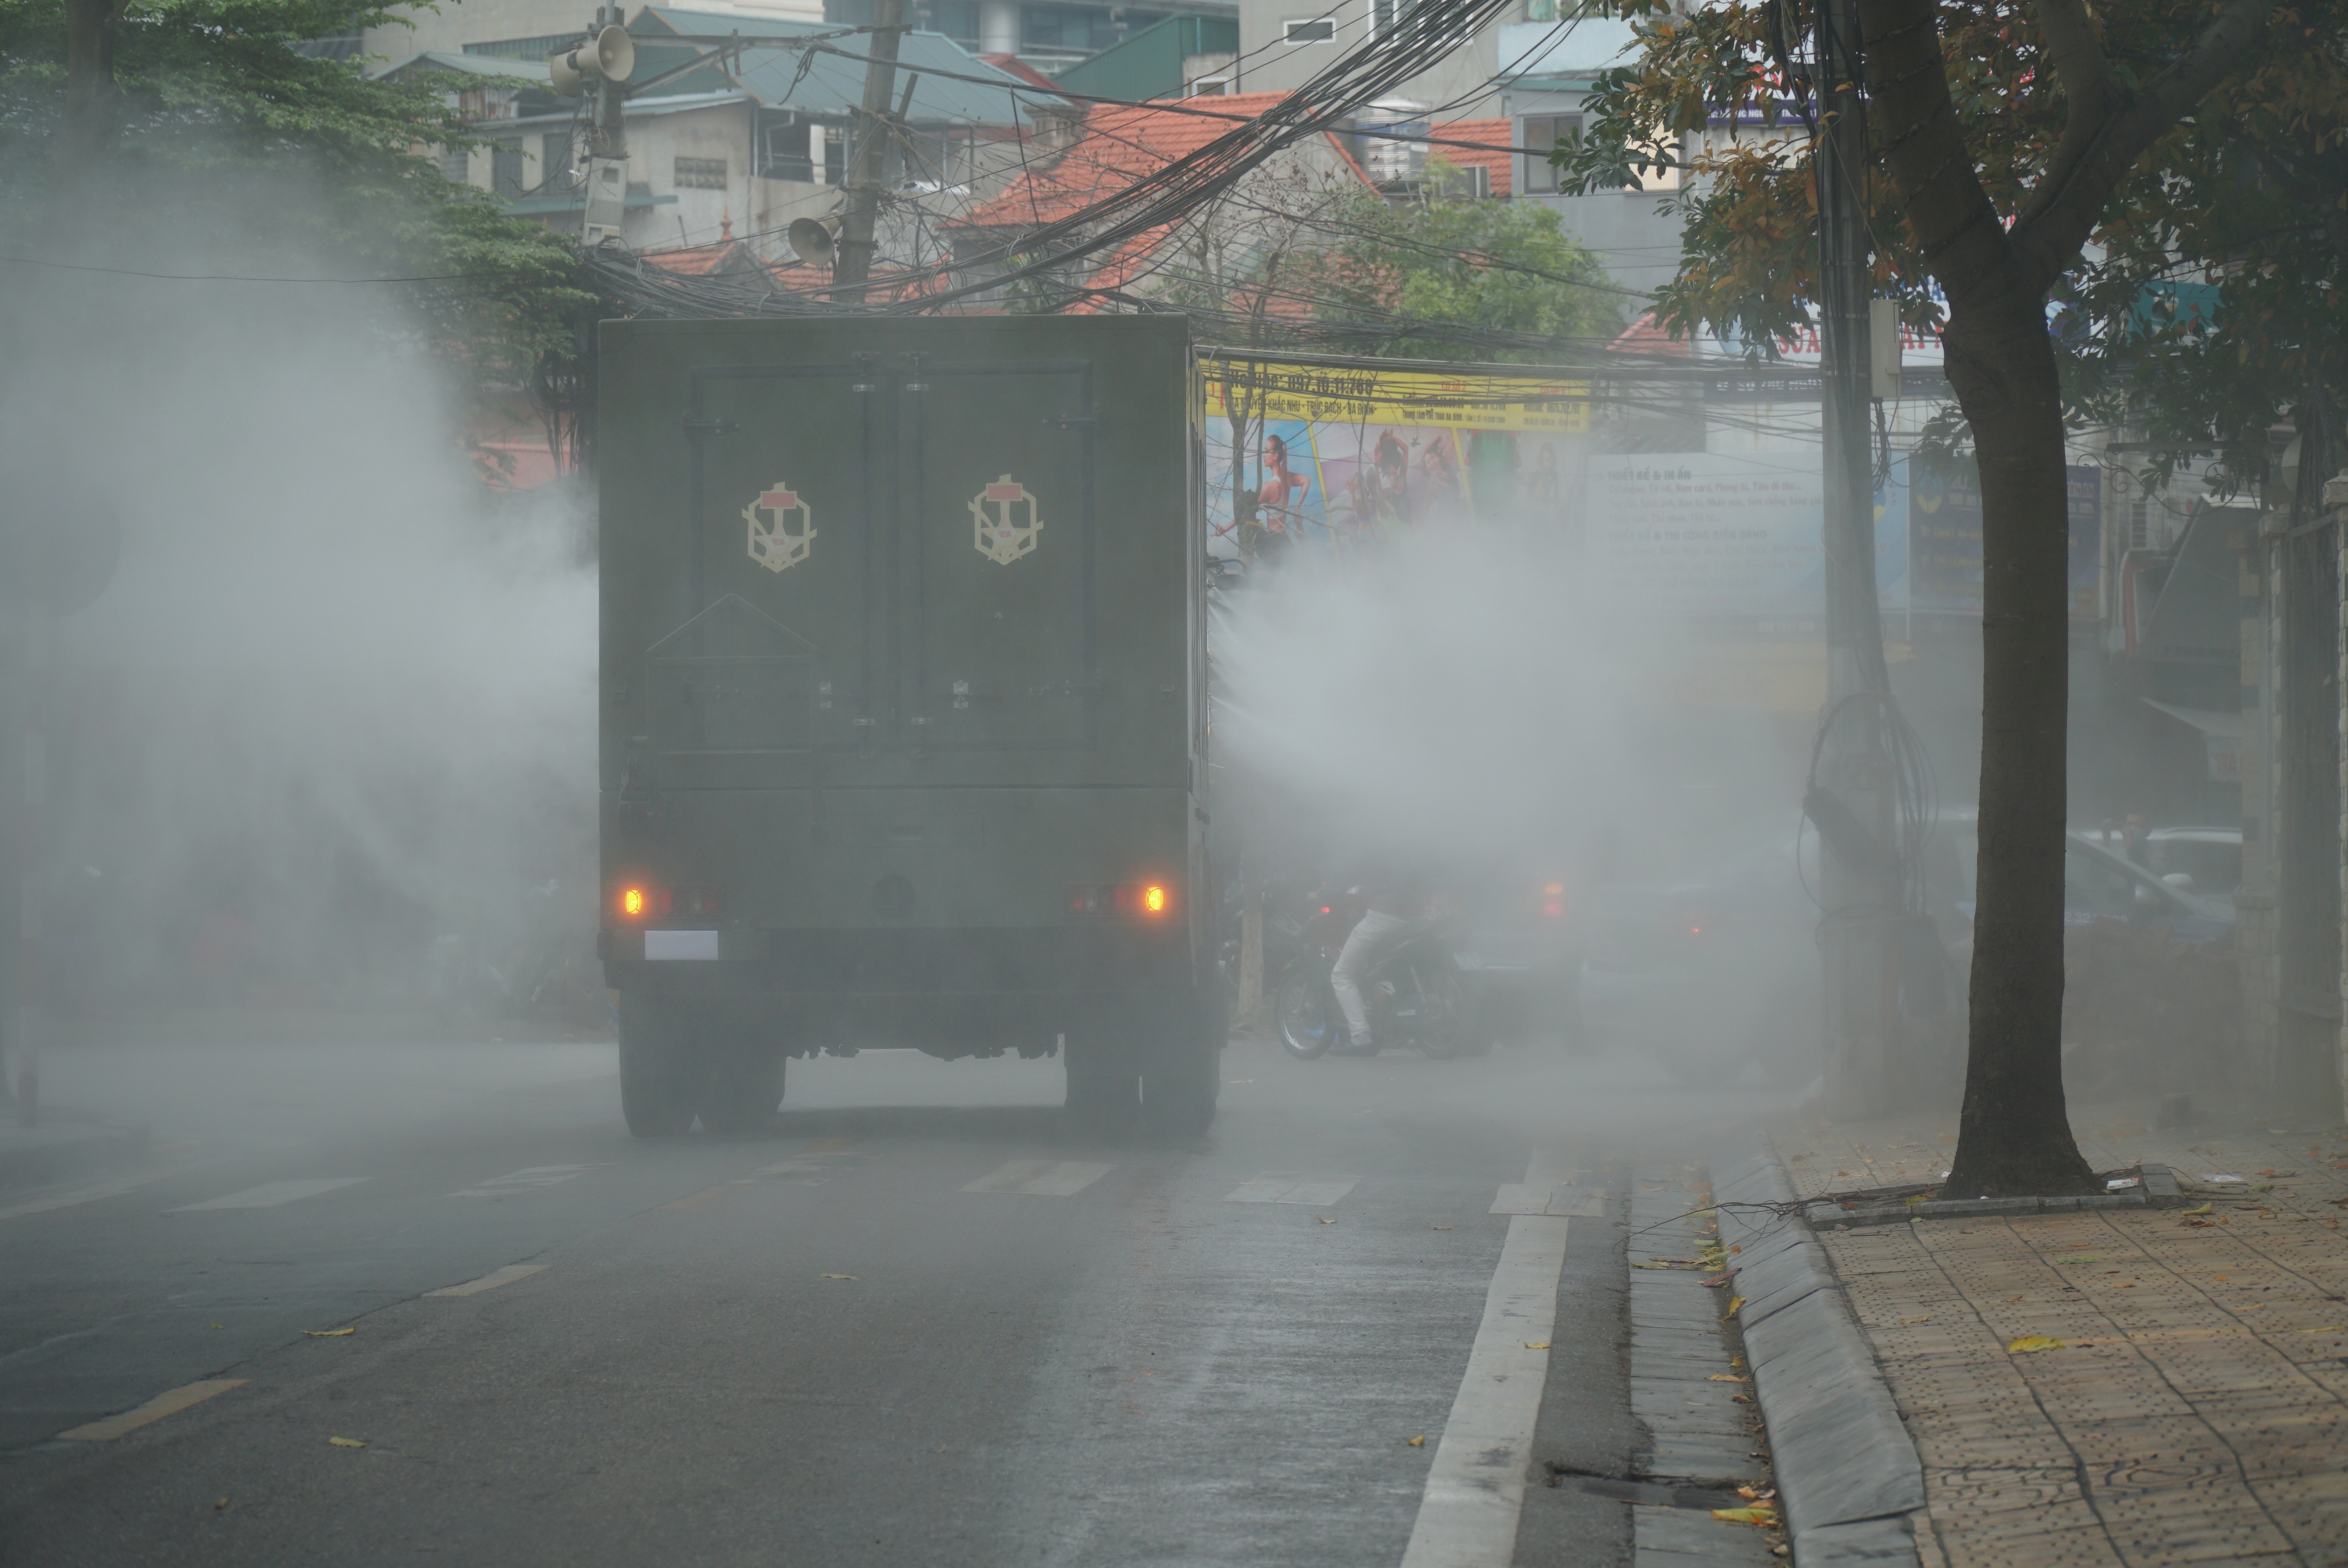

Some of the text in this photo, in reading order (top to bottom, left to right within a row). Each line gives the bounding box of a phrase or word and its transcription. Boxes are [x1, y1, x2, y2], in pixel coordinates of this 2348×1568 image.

[1287, 400, 1300, 412] NHU
[1608, 465, 1691, 481] THIẾT KẾ & IN ẤN
